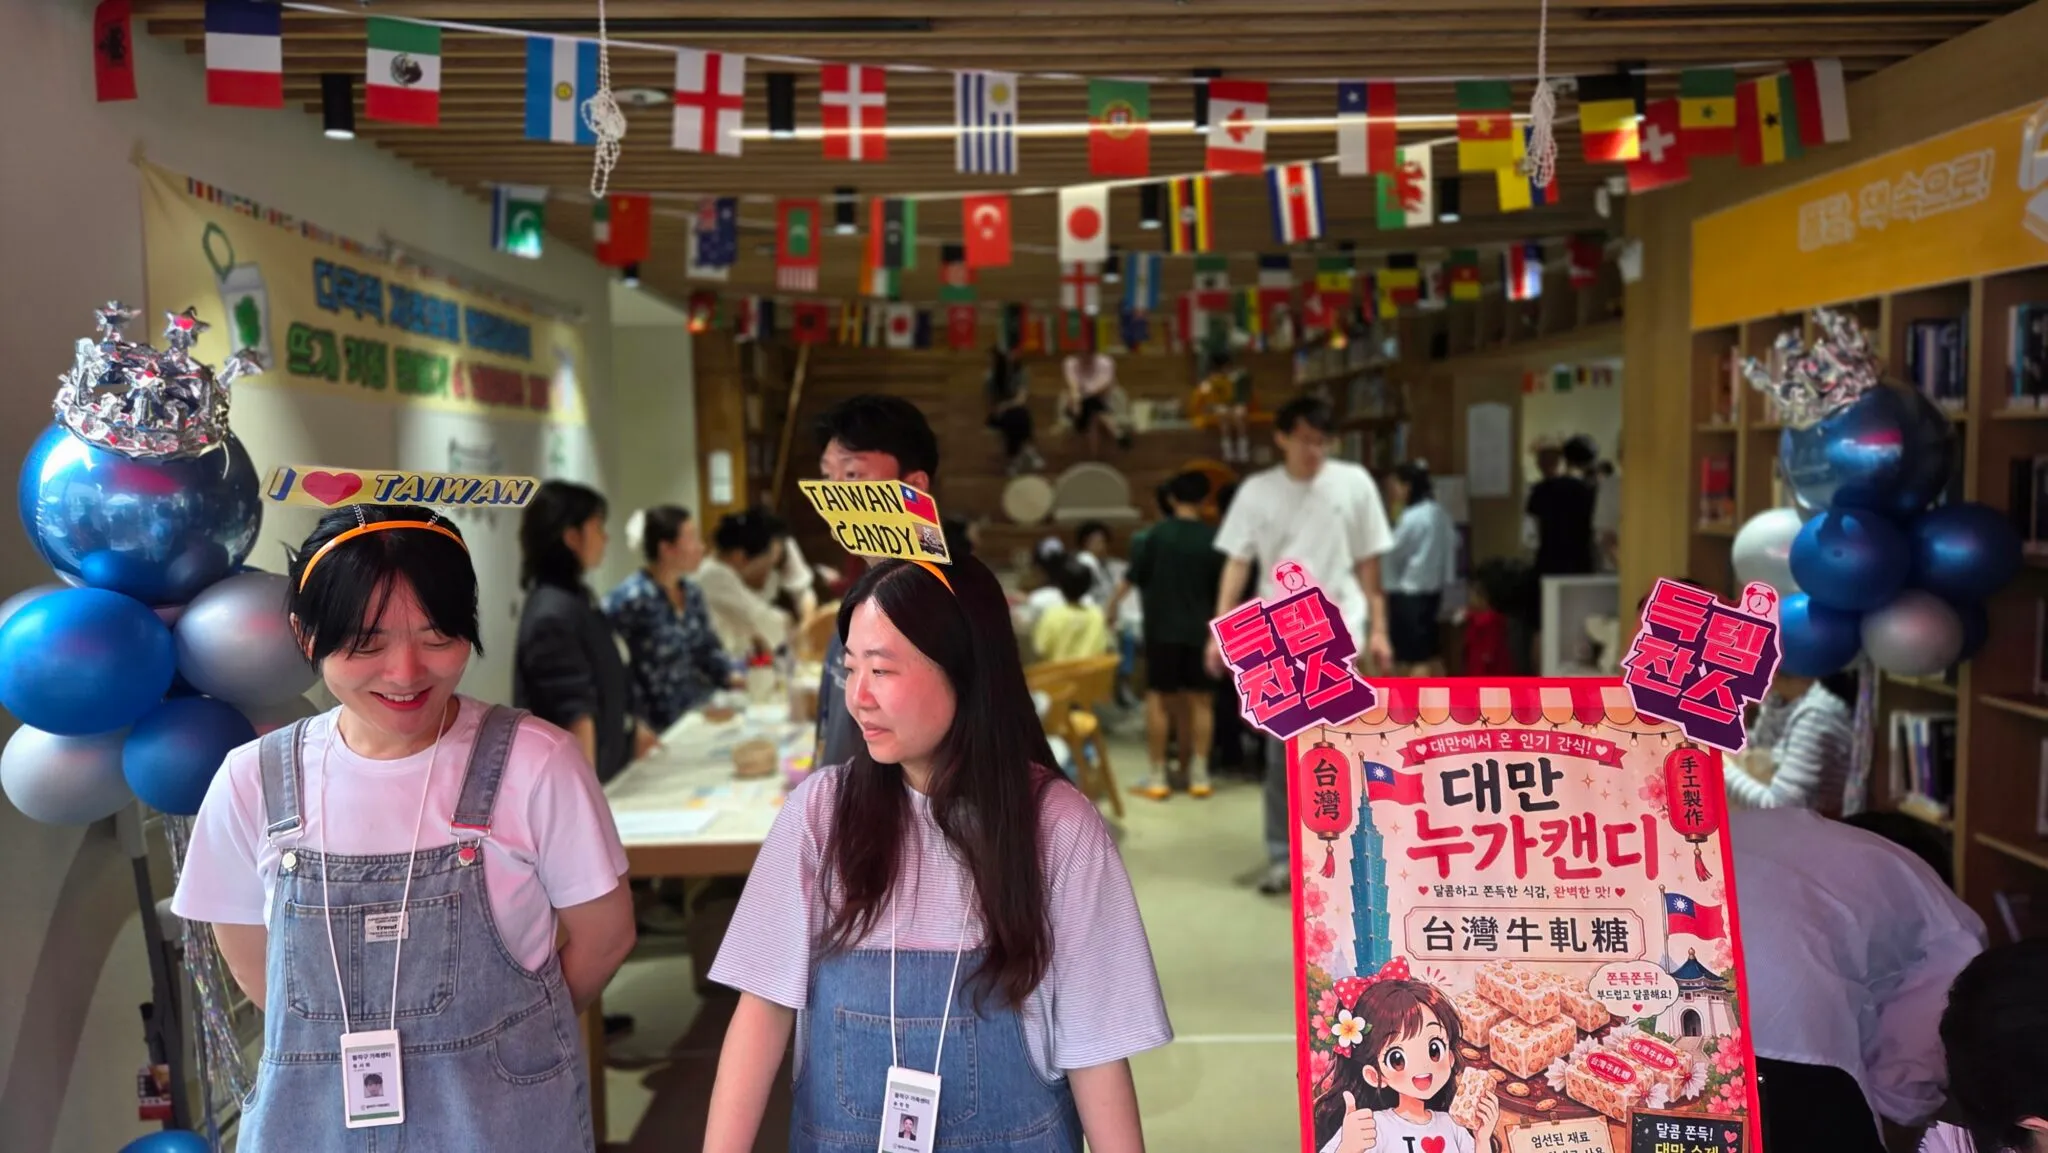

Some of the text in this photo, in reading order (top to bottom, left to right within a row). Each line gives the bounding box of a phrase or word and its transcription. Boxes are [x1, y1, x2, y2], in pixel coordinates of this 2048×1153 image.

[268, 467, 534, 504] I TAIWAN
[804, 483, 905, 514] TAIWAN
[836, 520, 915, 555] CANDY
[1216, 592, 1335, 664] 득템
[1647, 582, 1772, 675] 득템
[1240, 649, 1353, 723] 찬스
[1628, 634, 1738, 724] 찬스
[1430, 732, 1591, 755] 대만에서 온 인기 간식!
[1313, 758, 1341, 820] 台灣
[1440, 757, 1564, 814] 대만
[1680, 756, 1704, 826] 手工製作
[1406, 809, 1659, 881] 누가캔디
[1433, 885, 1611, 900] 달콤하고 쫀득한 식감, 완벽한 맛!
[1423, 915, 1630, 954] 台灣牛軋糖
[1597, 989, 1672, 1000] 부드럽고 달콤해요!
[1606, 972, 1659, 986] 쫀득쫀득!
[1402, 1136, 1416, 1153] I
[1531, 1131, 1591, 1149] 엄선된 재료
[1656, 1122, 1713, 1141] 달콤 쫀득!
